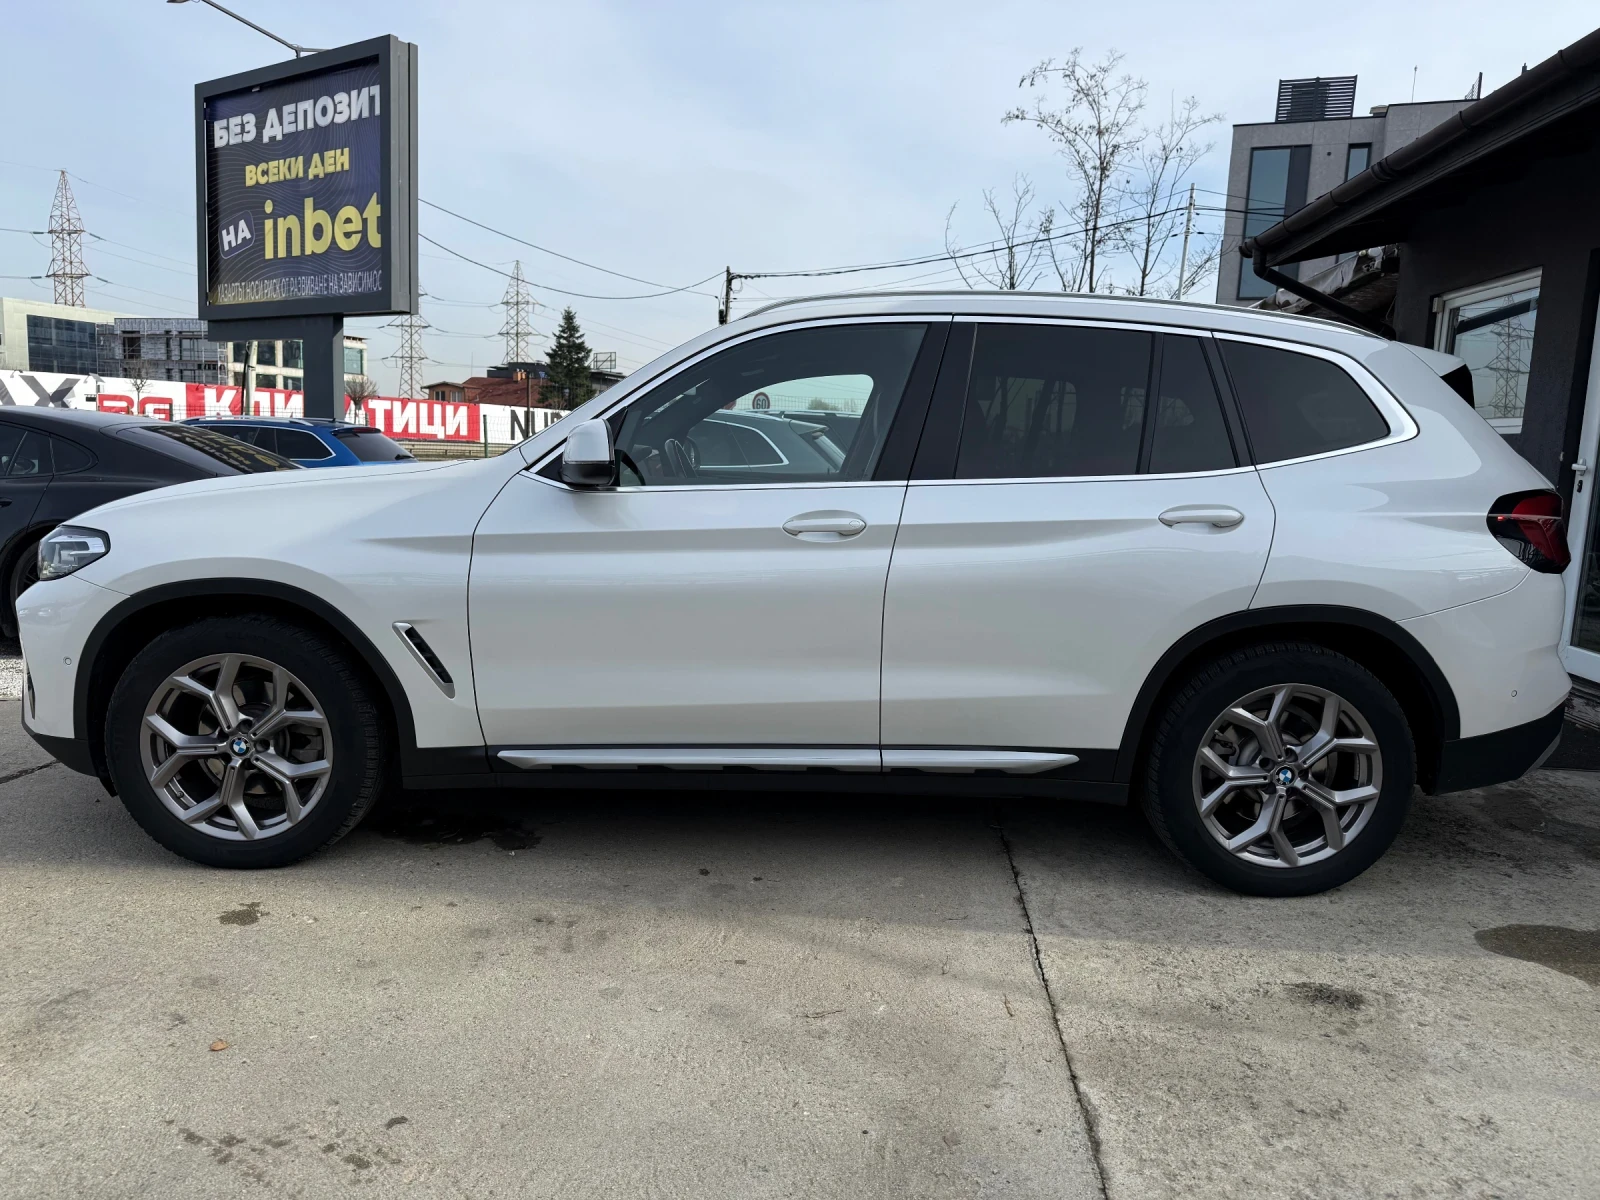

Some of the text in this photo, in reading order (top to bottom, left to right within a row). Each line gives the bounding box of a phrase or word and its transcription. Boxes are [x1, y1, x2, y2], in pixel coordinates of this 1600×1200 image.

[214, 85, 380, 149] БЕЗ ДЕПОЗИТ
[245, 147, 350, 187] ВСЕКИ ДЕН
[221, 219, 252, 252] НА
[264, 191, 382, 260] inbet
[246, 280, 263, 300] НОСИ
[264, 278, 281, 299] РИСК
[281, 277, 289, 297] ОТ
[290, 273, 328, 297] РАЗВИВАНЕ
[328, 273, 339, 294] НА
[756, 398, 766, 409] 60
